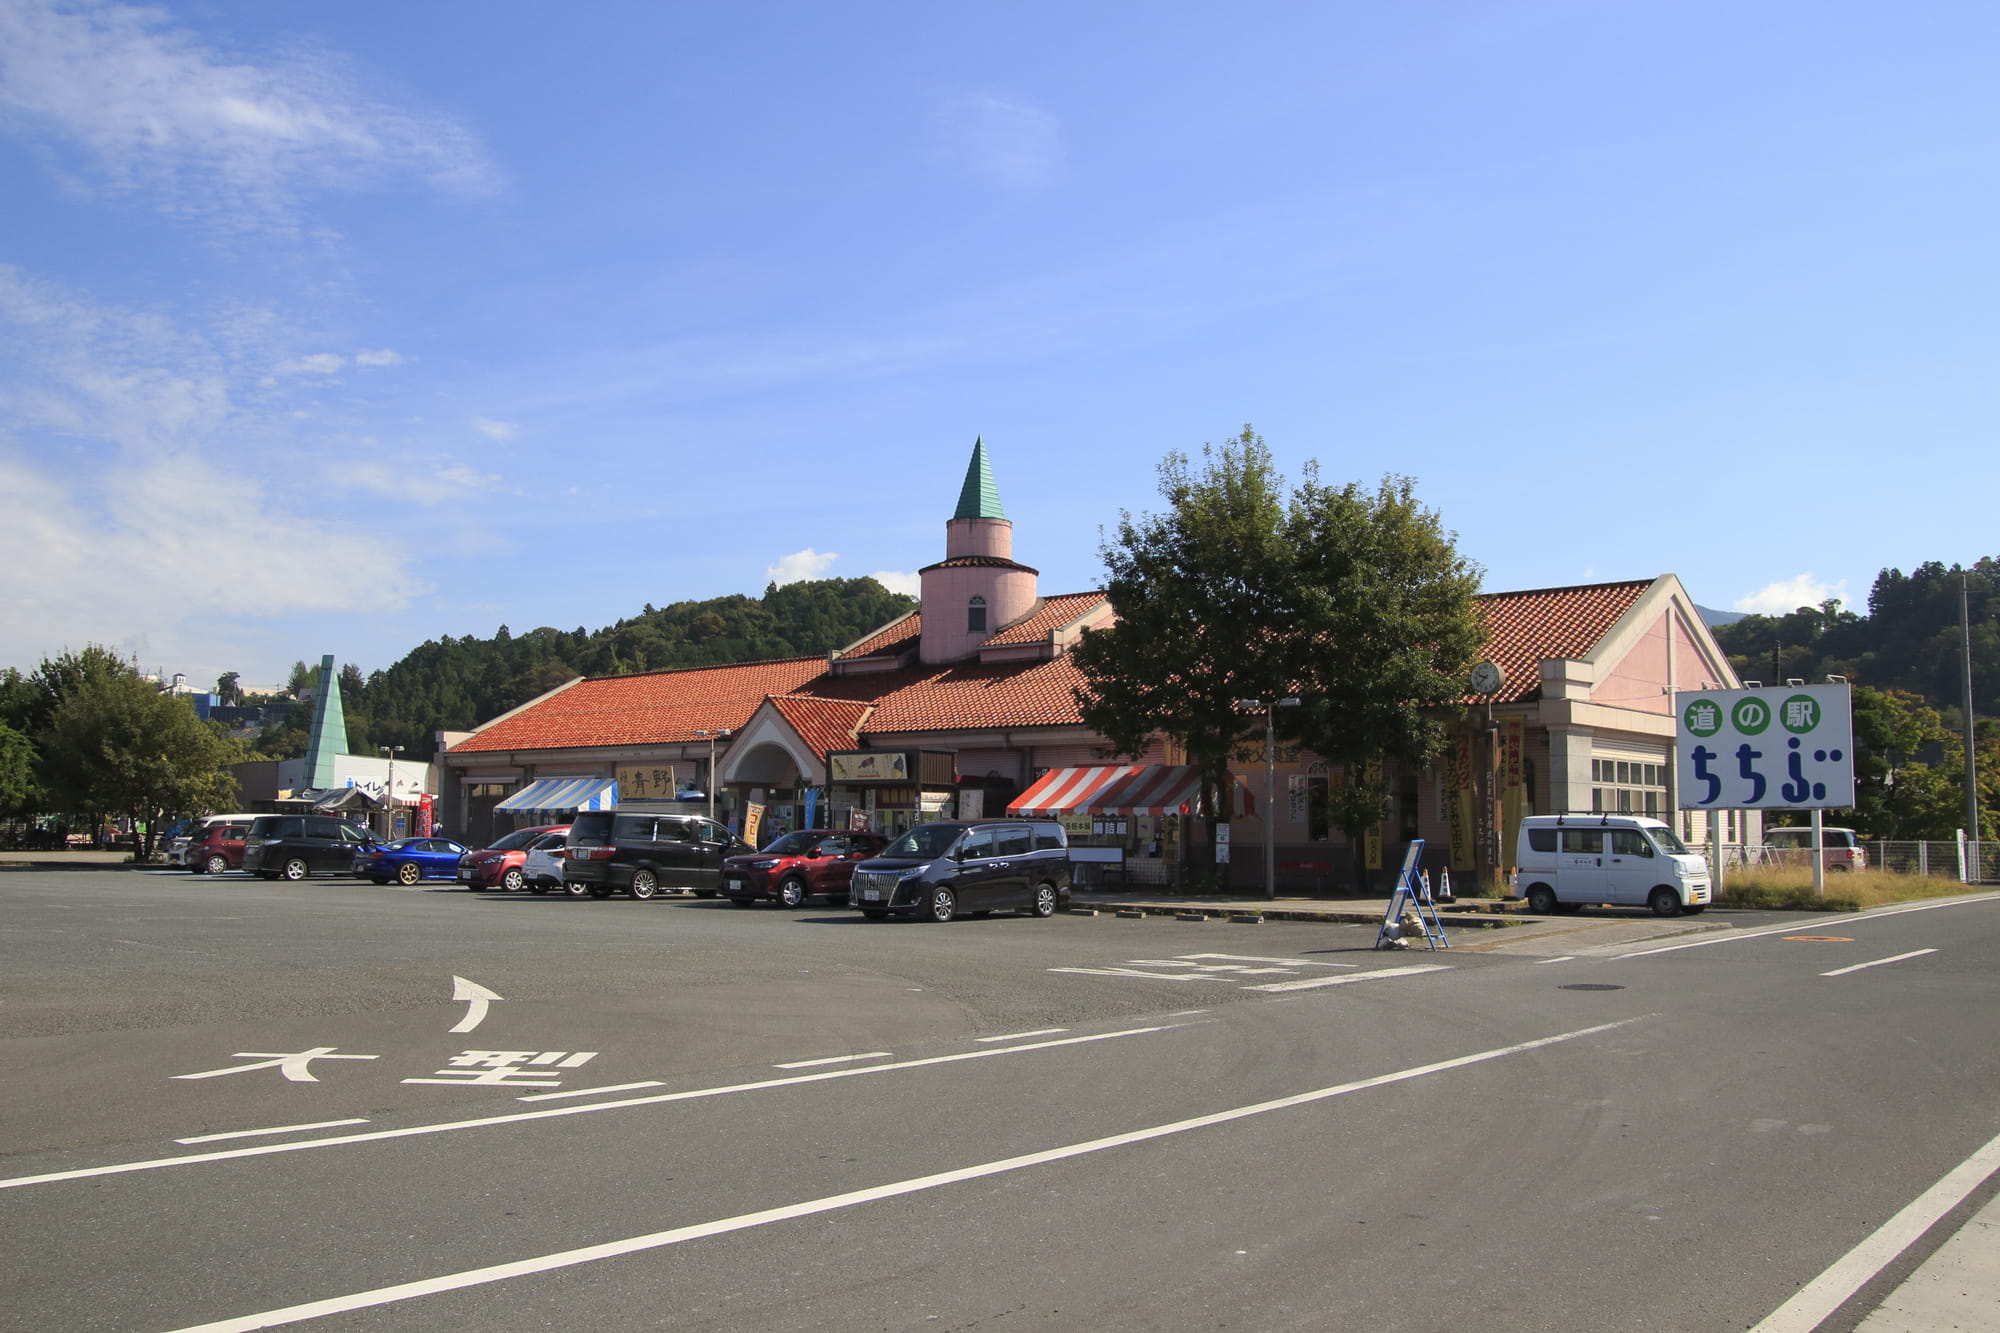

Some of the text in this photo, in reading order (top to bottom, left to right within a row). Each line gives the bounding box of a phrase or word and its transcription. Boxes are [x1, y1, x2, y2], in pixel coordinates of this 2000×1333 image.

[1690, 701, 1813, 731] 道の駅
[355, 780, 381, 792] トイレ
[1691, 737, 1842, 804] ちちぶ
[168, 1047, 599, 1087] 大型
